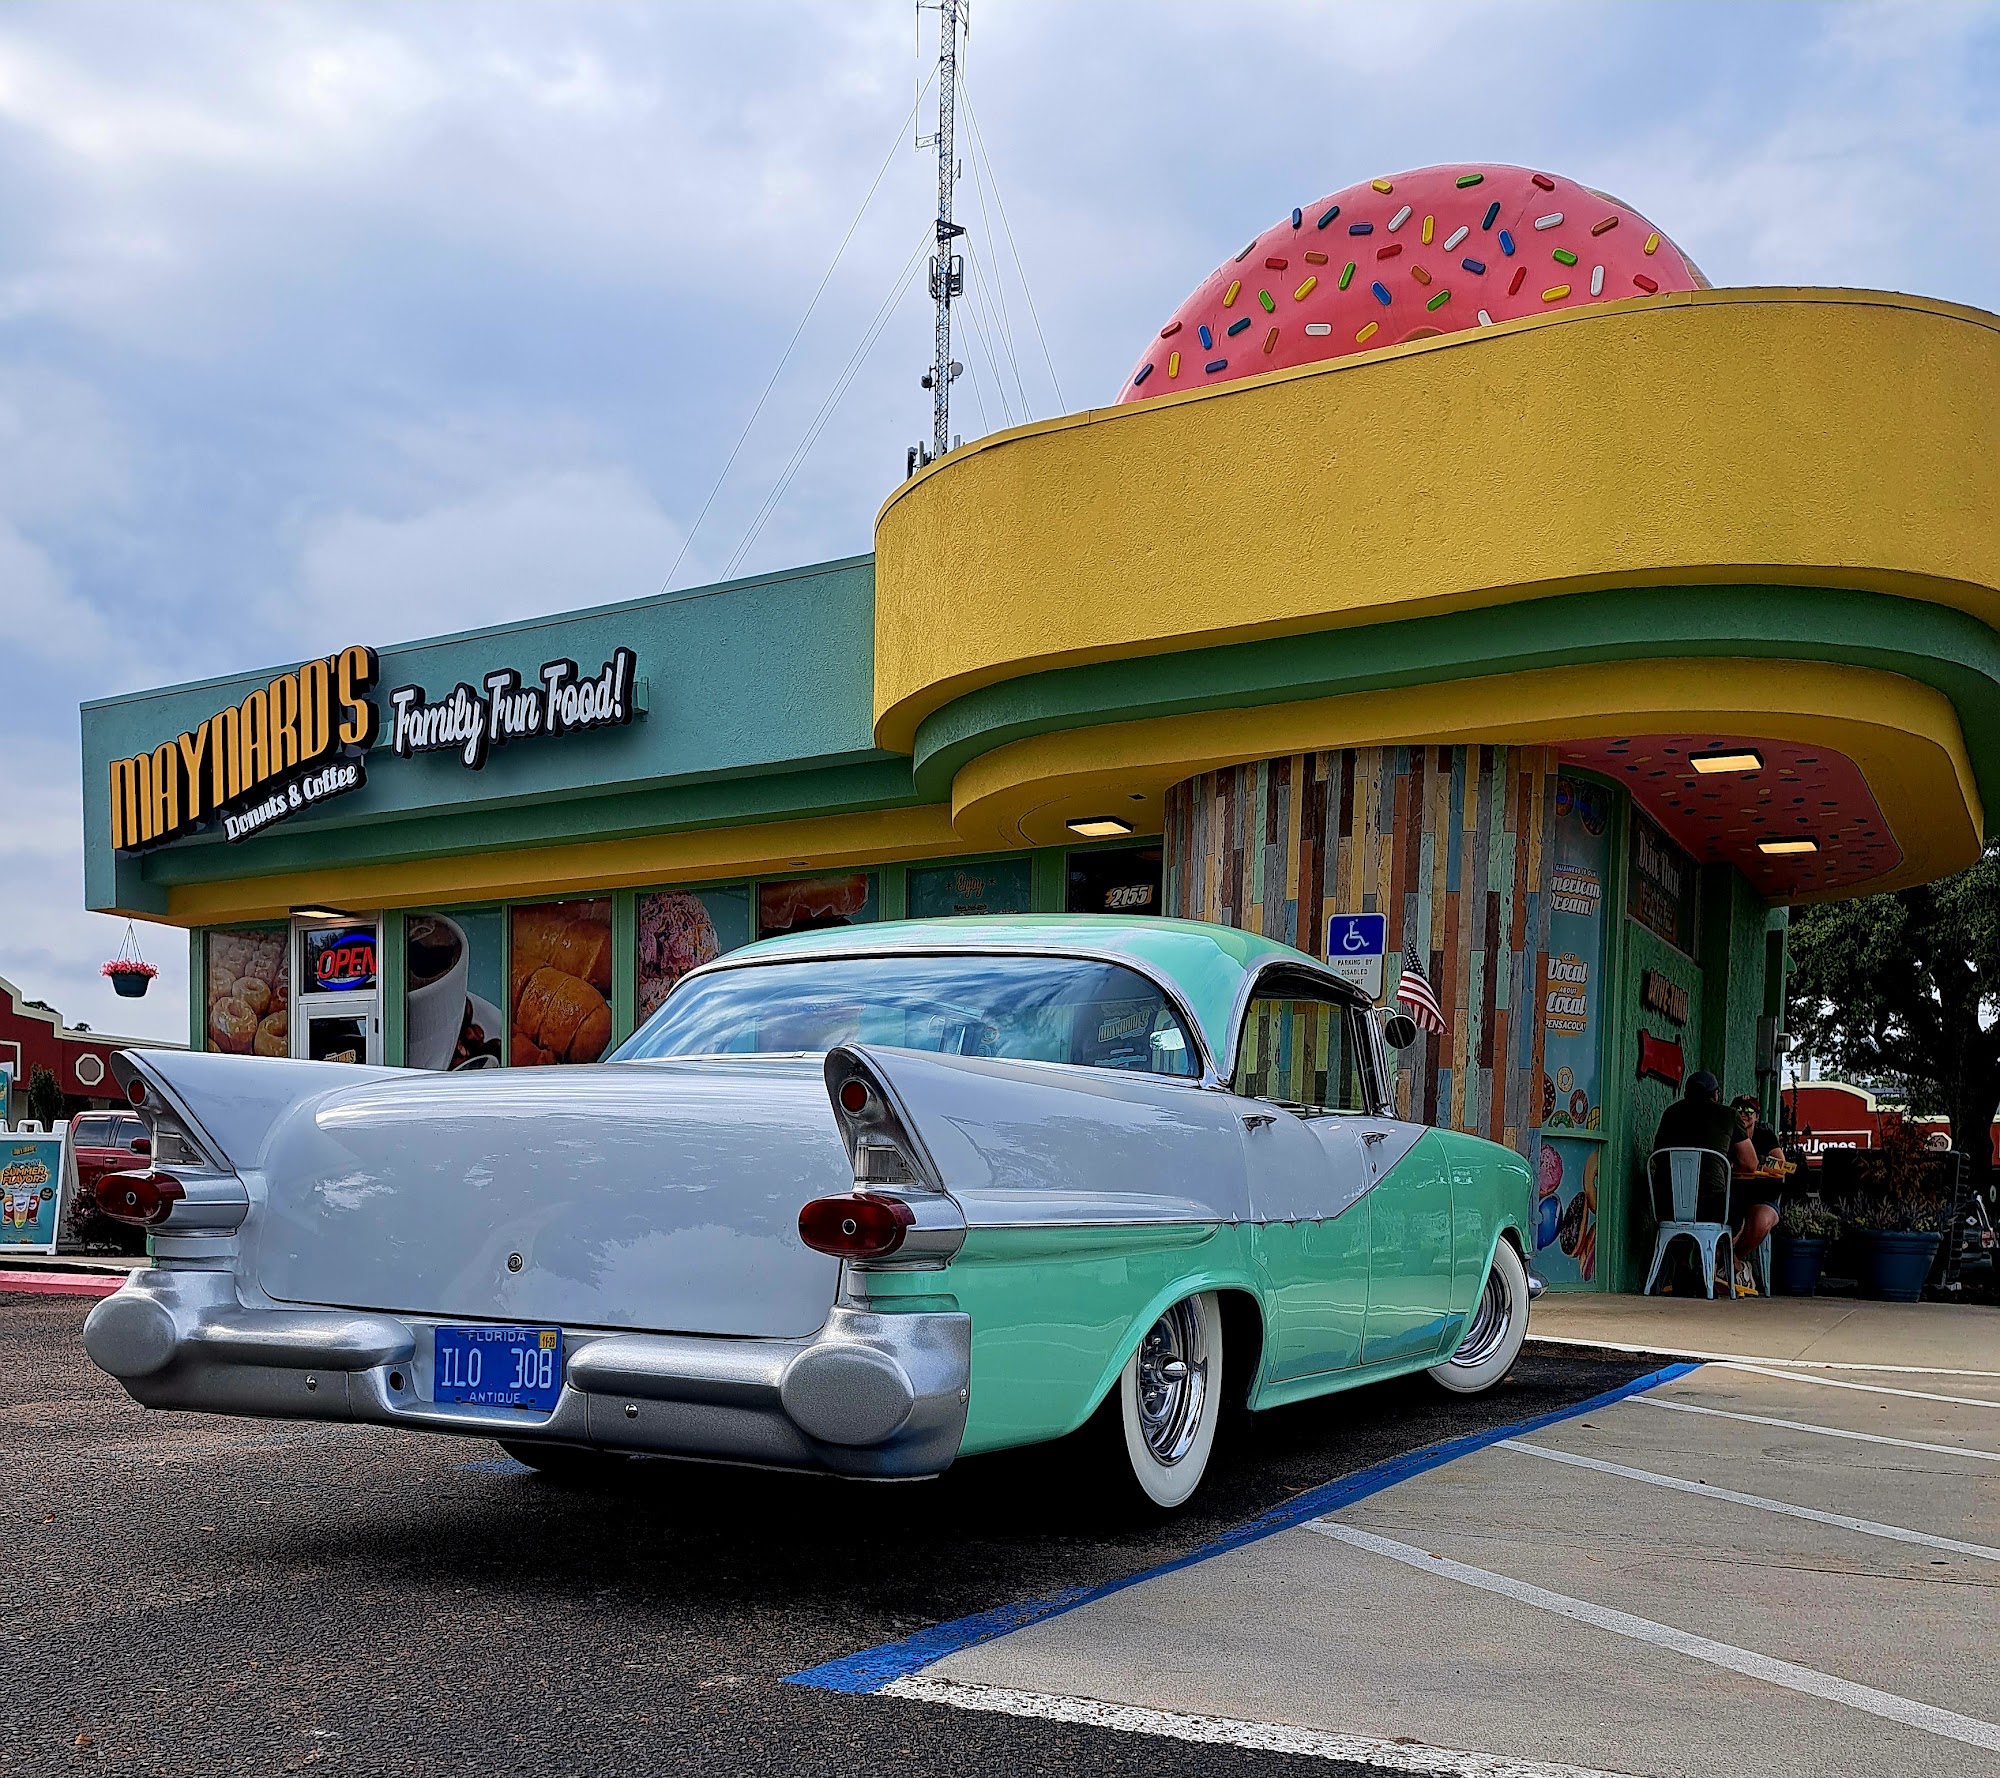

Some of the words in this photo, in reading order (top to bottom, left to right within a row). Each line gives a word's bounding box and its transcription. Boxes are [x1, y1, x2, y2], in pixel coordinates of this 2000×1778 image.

[393, 687, 483, 764] Family
[487, 673, 540, 739] Fun
[544, 652, 626, 731] Food!
[110, 645, 369, 849] MAYNARD'S
[224, 794, 287, 841] Donuts
[288, 786, 302, 807] &
[303, 765, 358, 801] Coffee
[956, 873, 985, 898] Enjoy
[1110, 885, 1150, 907] 2155
[318, 946, 377, 979] OPEN
[1337, 959, 1361, 967] PARKING
[1365, 958, 1373, 966] BY
[1341, 968, 1368, 976] DISABLED
[1548, 958, 1588, 984] Vocal
[2, 1174, 46, 1185] FLAVORS
[3, 1166, 45, 1176] SUMMER
[468, 1330, 526, 1342] FLORIDA
[441, 1347, 482, 1388] ILO
[469, 1391, 521, 1404] ANTIQUE
